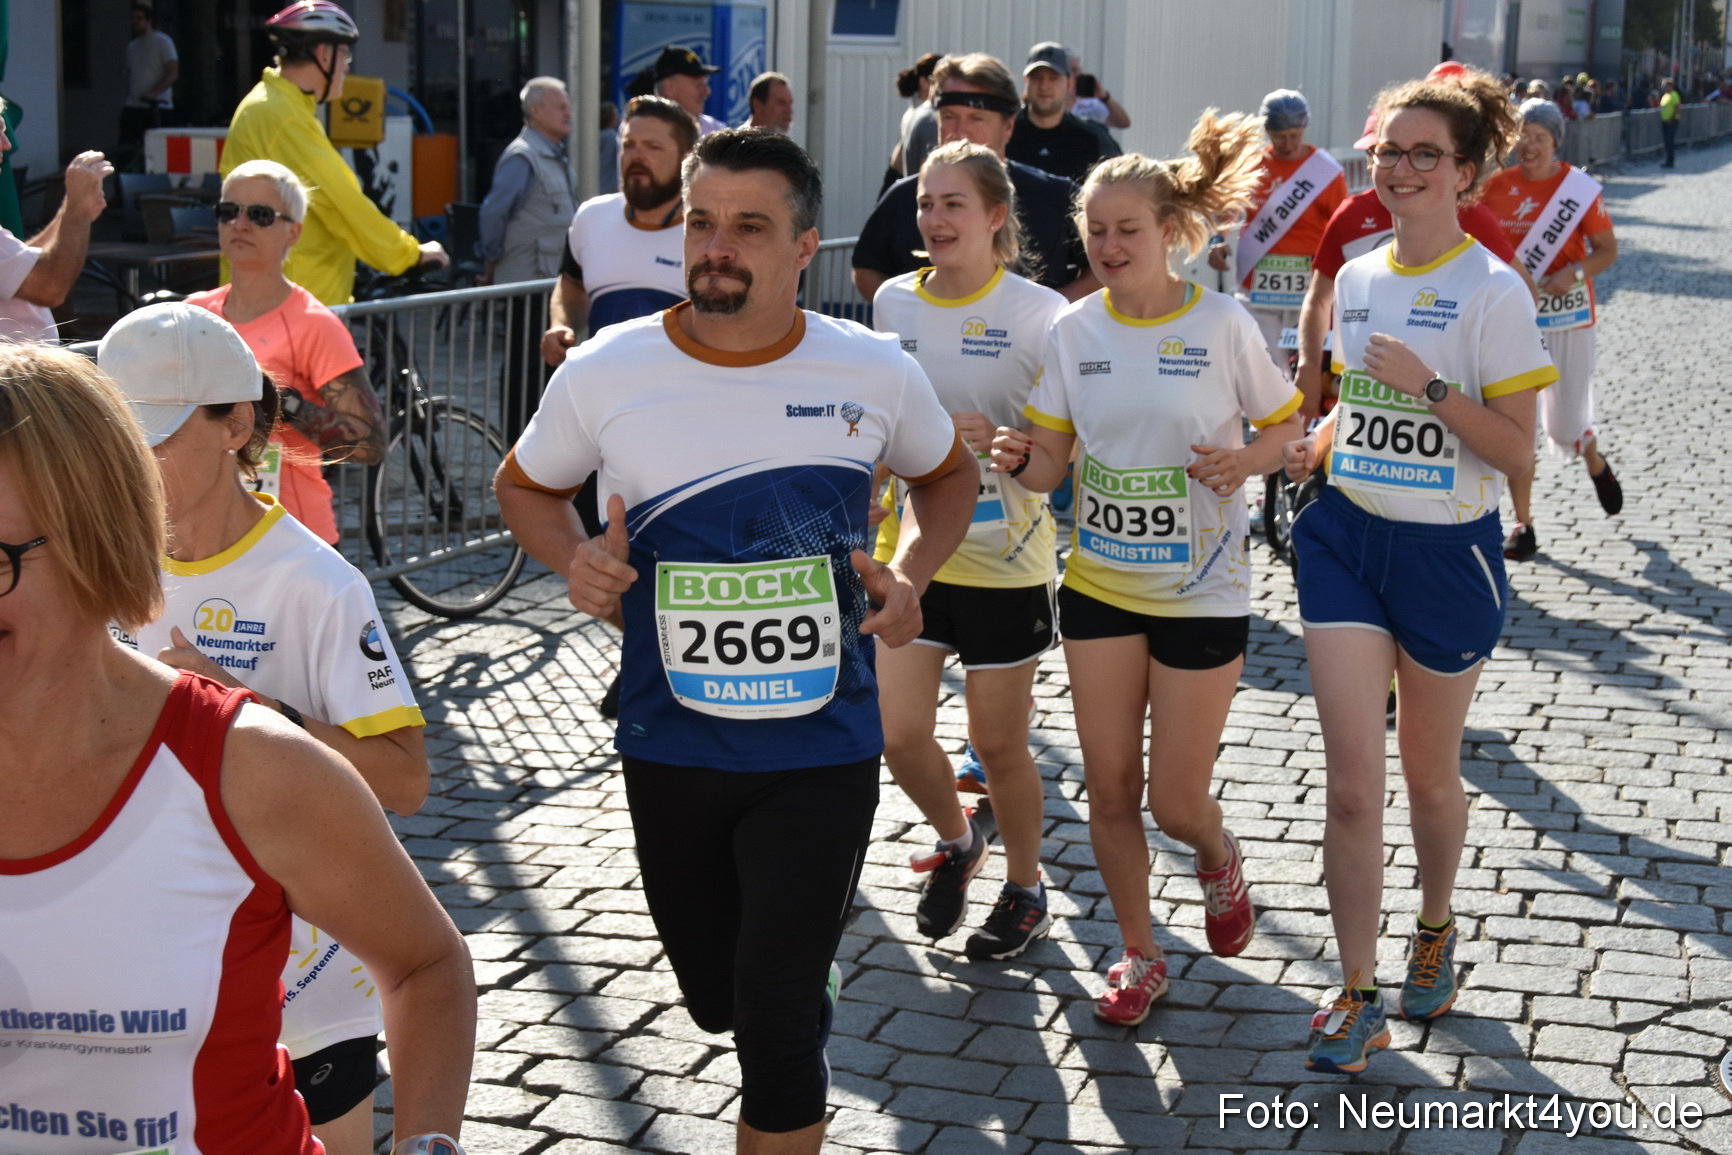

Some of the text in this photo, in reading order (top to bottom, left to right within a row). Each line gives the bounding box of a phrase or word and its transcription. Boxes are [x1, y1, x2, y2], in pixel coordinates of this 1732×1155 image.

[1254, 217, 1278, 244] wir
[1276, 178, 1315, 220] auch
[1542, 197, 1580, 246] auch
[1257, 273, 1305, 291] 2613
[1414, 292, 1437, 307] 20
[1538, 290, 1584, 314] 2069
[1410, 308, 1460, 320] Neumarkter
[964, 321, 986, 337] 20
[1406, 318, 1448, 332] Stadtlauf
[962, 337, 1011, 350] Neumarkter
[1161, 340, 1184, 356] 20
[960, 347, 1001, 359] Stadtlauf
[1079, 361, 1111, 372] BOCK
[1158, 357, 1212, 368] Neumarkter
[1158, 367, 1201, 379] Stadtlauf
[785, 404, 836, 417] Schmer.IT
[1346, 412, 1443, 458] 2060
[1087, 462, 1176, 495] BOCK
[1340, 457, 1442, 484] ALEXANDRA
[1087, 495, 1175, 537] 2039
[1090, 536, 1172, 561] CHRISTIN
[672, 567, 815, 602] BOCK
[198, 607, 264, 633] 20 JAHRE
[823, 616, 832, 625] D
[196, 634, 276, 652] Neumarkter
[679, 615, 820, 666] 2669
[204, 653, 259, 671] adtlauf
[703, 679, 802, 701] DANIEL
[296, 942, 341, 990] Septemb
[121, 1008, 187, 1034] Wild
[16, 1039, 152, 1055] Krankengymnastik
[76, 1110, 128, 1142] Sie
[135, 1110, 178, 1148] fit!
